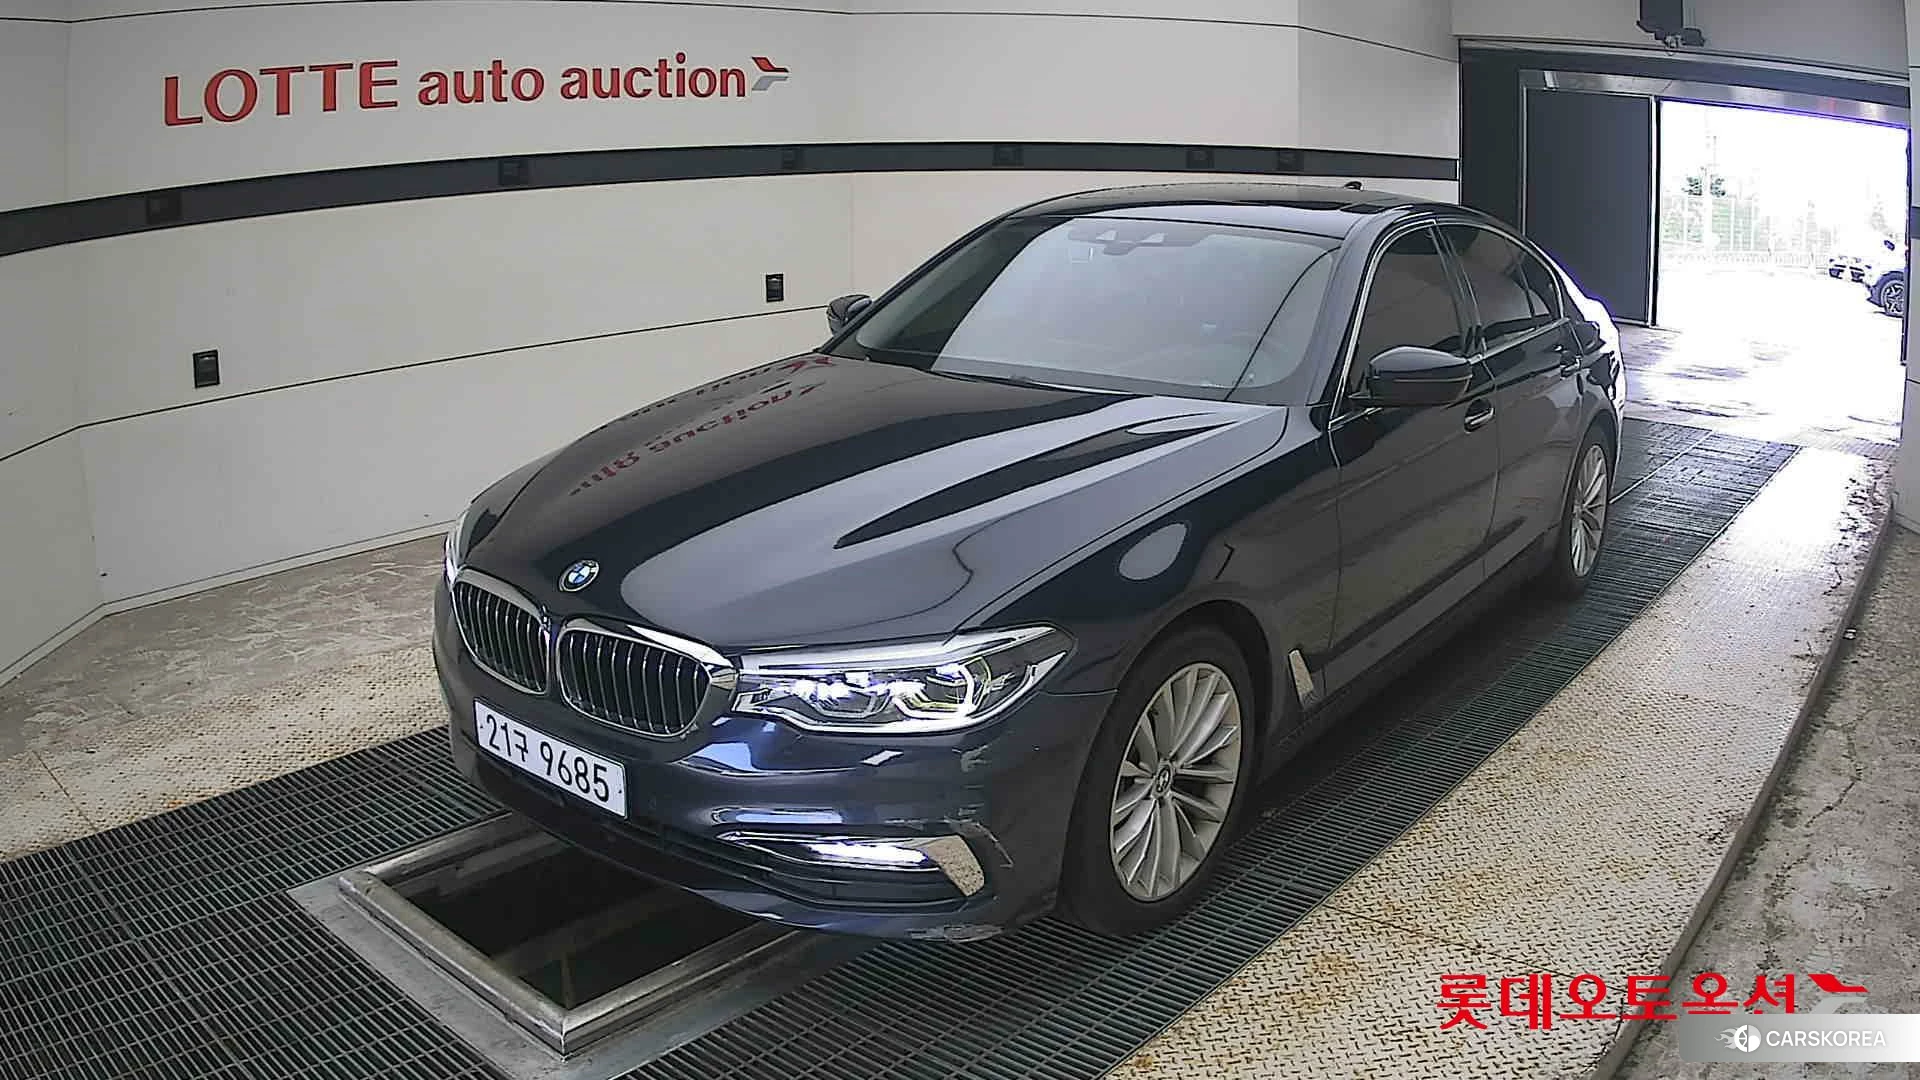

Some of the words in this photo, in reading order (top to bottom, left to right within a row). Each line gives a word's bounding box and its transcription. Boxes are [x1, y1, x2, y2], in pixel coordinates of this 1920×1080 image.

[164, 60, 398, 126] LOTTE
[417, 59, 545, 106] auto
[560, 52, 747, 99] auction
[539, 740, 610, 803] 9685
